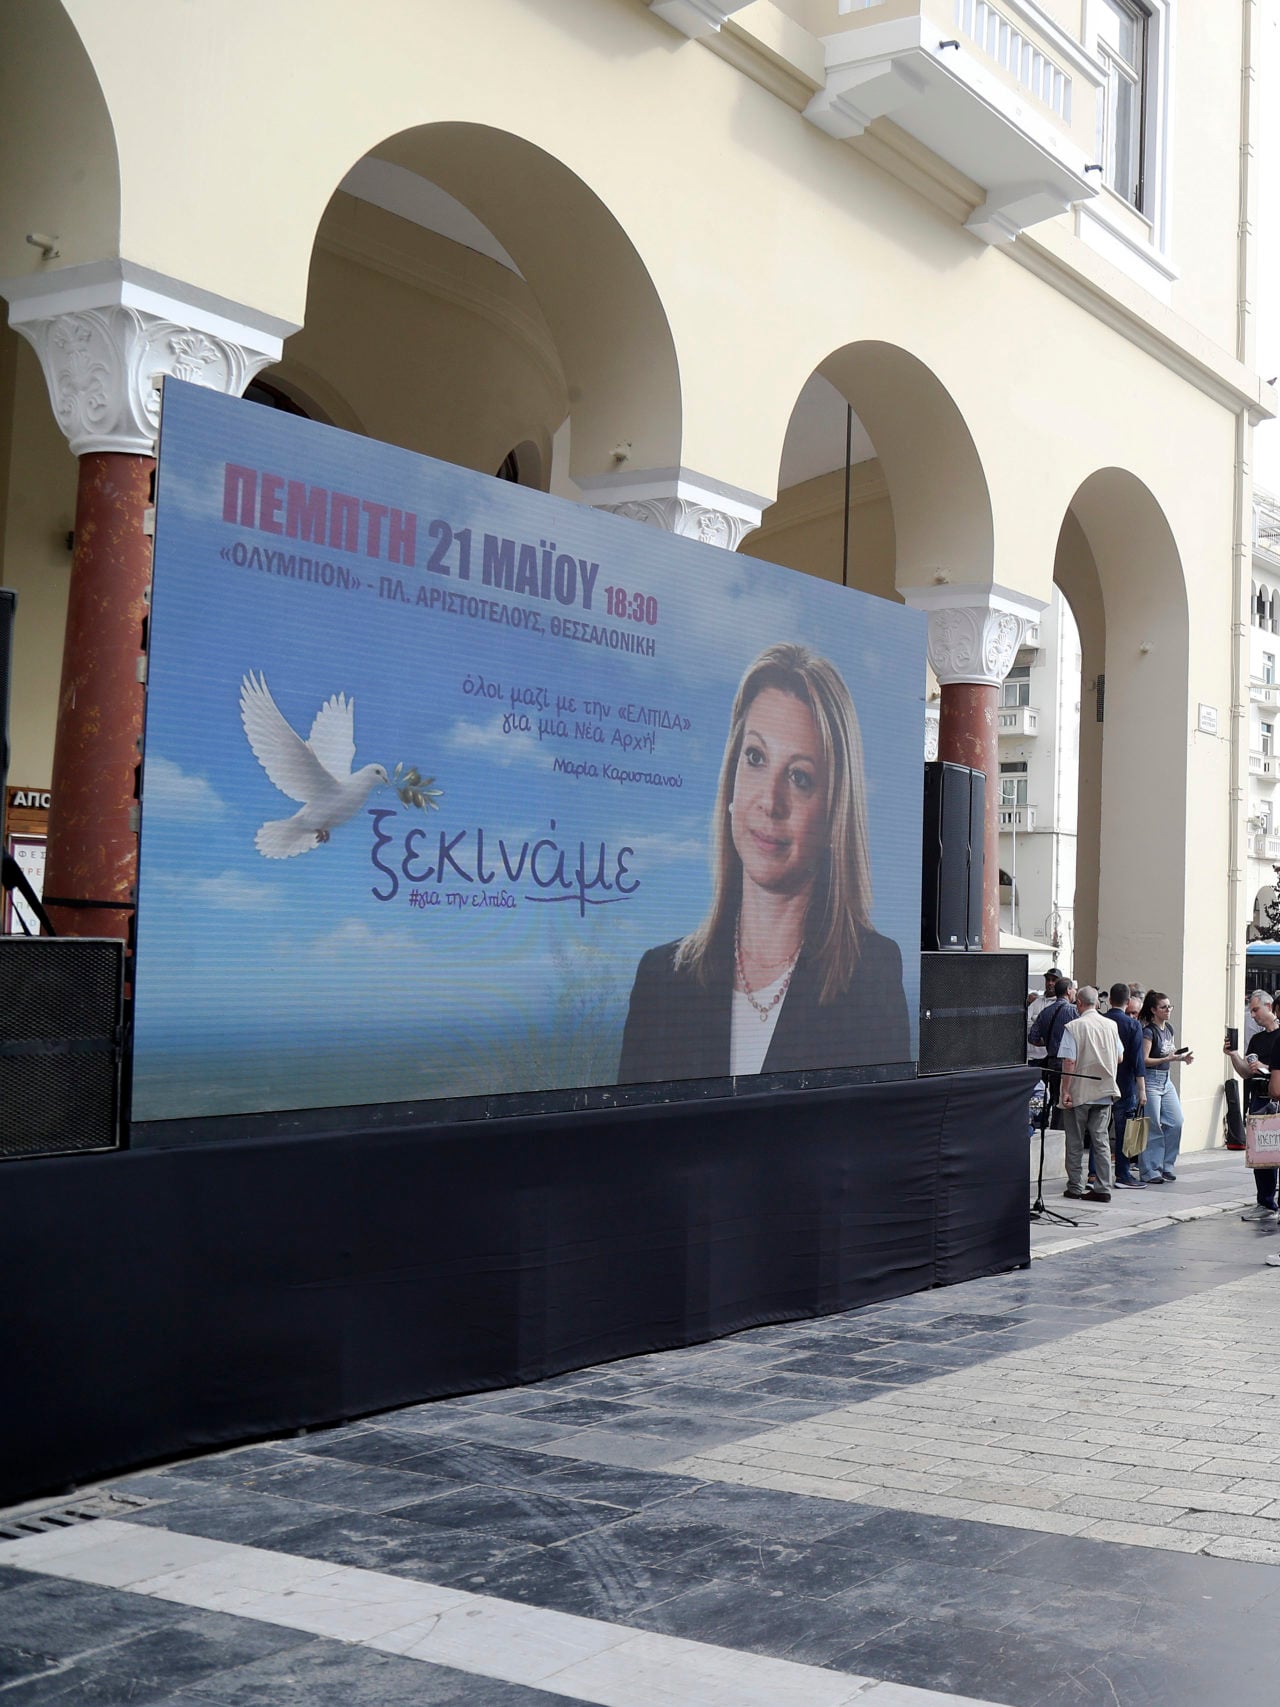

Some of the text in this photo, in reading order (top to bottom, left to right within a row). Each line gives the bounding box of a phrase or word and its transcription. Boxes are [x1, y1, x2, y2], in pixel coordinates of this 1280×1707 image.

[223, 462, 658, 626] ΠΕΜΠΤΗ 21 ΜΑΪΟΥ 18:30
[219, 541, 361, 590] «ΟΛΥΜΠΙΟΝ»
[379, 576, 411, 604] ΠΛ.
[416, 586, 546, 637] ΑΡΙΣΤΟΤΕΛΟΥΣ,
[551, 616, 656, 657] ΘΕΣΣΑΛΟΝΙΚΗ
[462, 674, 692, 732] όλοι μαζί με την «ΕΛΠΙΔΑ»
[502, 712, 656, 754] για μια Νέα Αρχή!
[553, 757, 683, 788] Μαρία Καρυστιανού
[367, 808, 641, 918] ξεκινάμε
[408, 889, 517, 910] #για την ελπίδα
